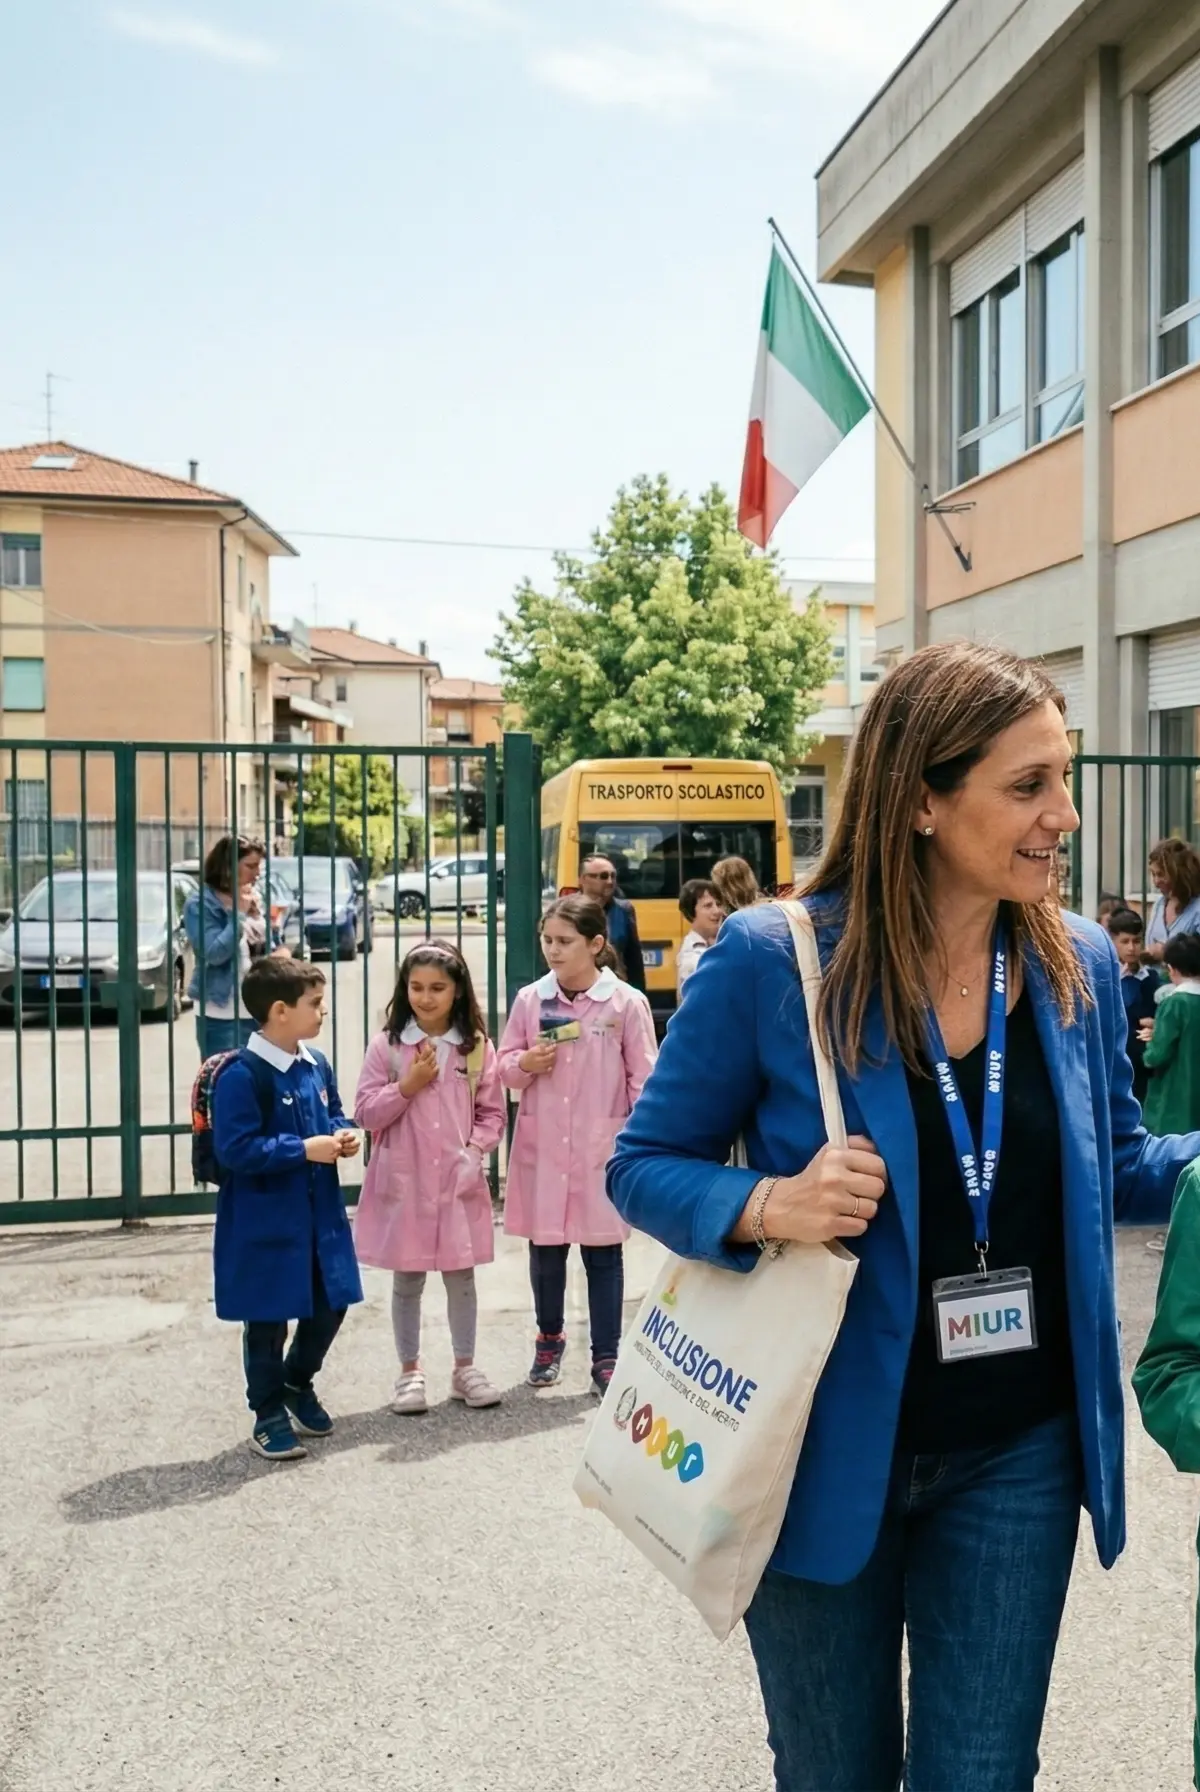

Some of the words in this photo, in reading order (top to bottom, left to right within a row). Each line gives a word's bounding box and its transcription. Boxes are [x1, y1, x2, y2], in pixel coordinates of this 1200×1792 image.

[588, 784, 673, 800] TRASPORTO
[679, 784, 765, 800] SCOLASTICO
[947, 1307, 1024, 1341] MIUR
[642, 1305, 758, 1414] INCLUSIONE
